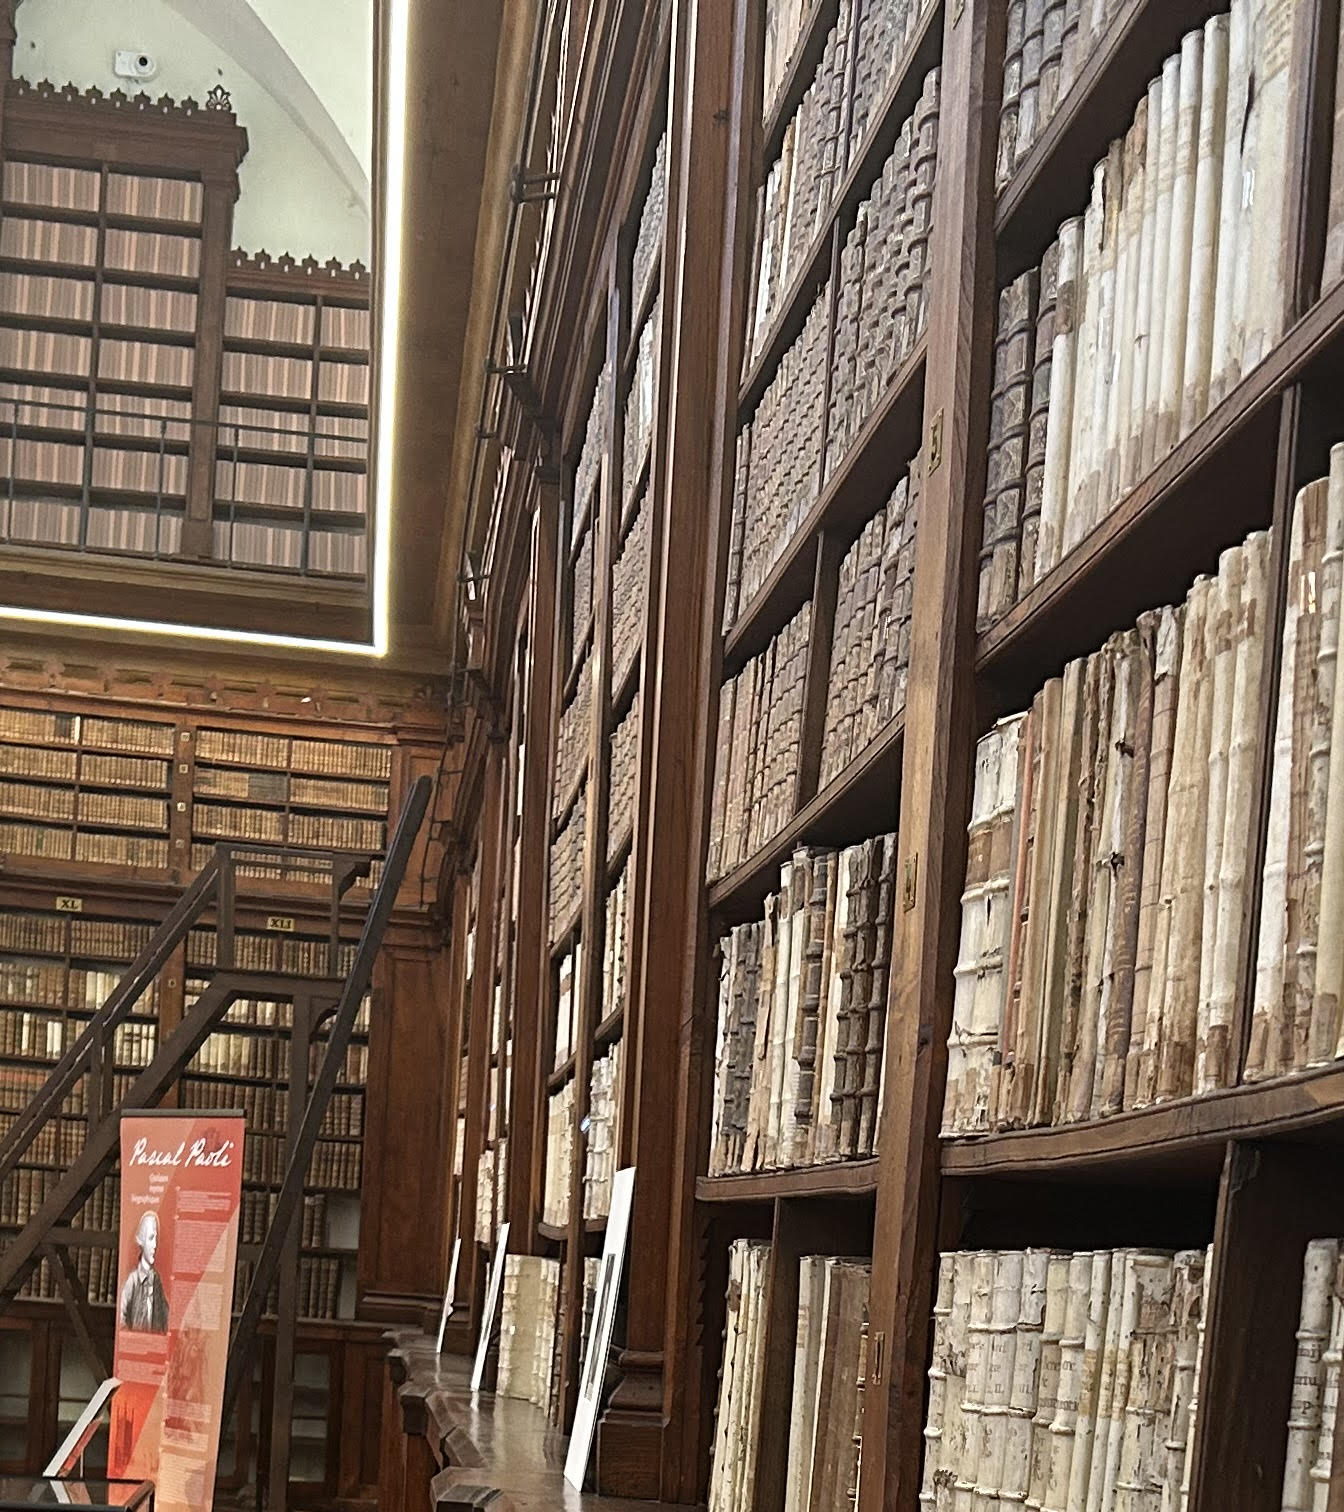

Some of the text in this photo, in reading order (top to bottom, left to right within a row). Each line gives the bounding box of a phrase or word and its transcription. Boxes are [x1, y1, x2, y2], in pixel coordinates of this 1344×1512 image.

[61, 899, 79, 910] XL
[129, 1136, 235, 1168] Pascal Paoli
